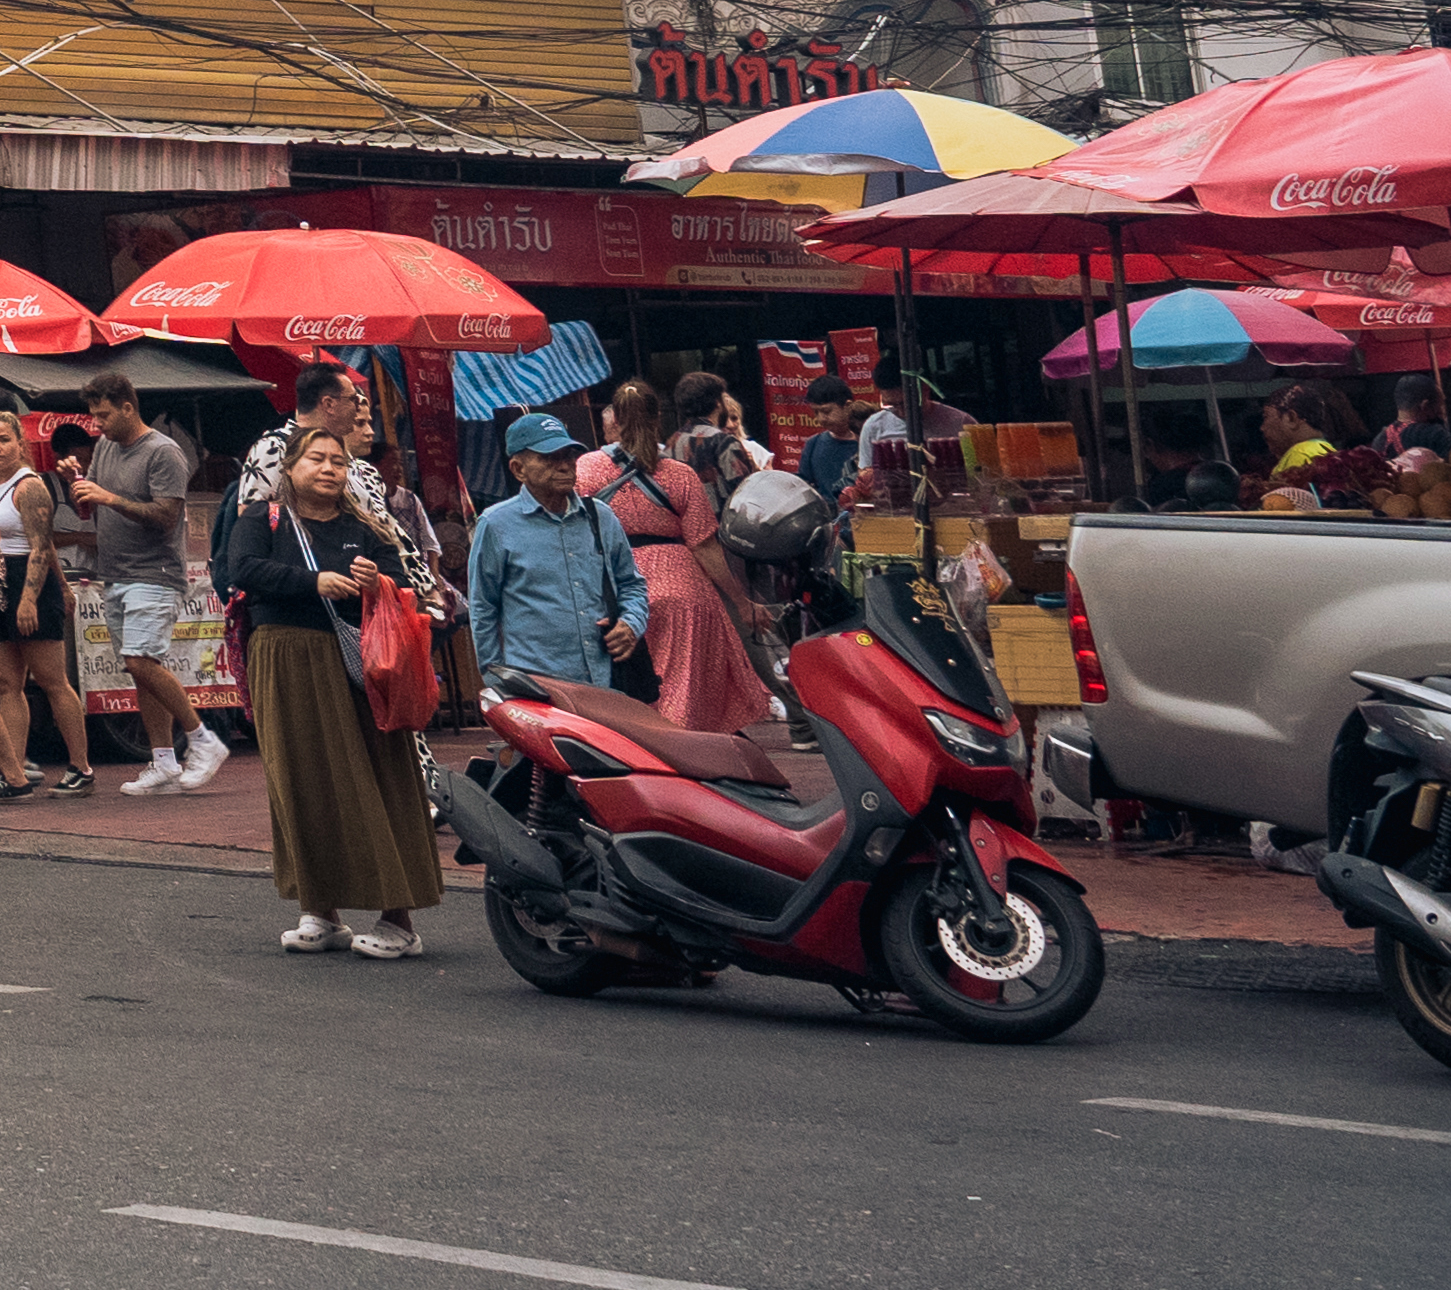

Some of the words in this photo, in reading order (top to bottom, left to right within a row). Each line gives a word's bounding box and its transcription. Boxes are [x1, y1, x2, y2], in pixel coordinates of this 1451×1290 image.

[649, 20, 879, 107] ต้นตำรับ
[1270, 164, 1398, 210] Coca-Cola
[431, 200, 553, 254] ต้นตำรับ
[705, 246, 767, 264] Authentic
[770, 248, 794, 264] Thai
[129, 280, 235, 309] Coca-Cola
[284, 313, 366, 341] Coca-Cola
[458, 312, 513, 340] Coca-Cola
[1359, 301, 1436, 326] Coca-Cola
[770, 412, 795, 427] Pad
[97, 693, 138, 711] โทร.
